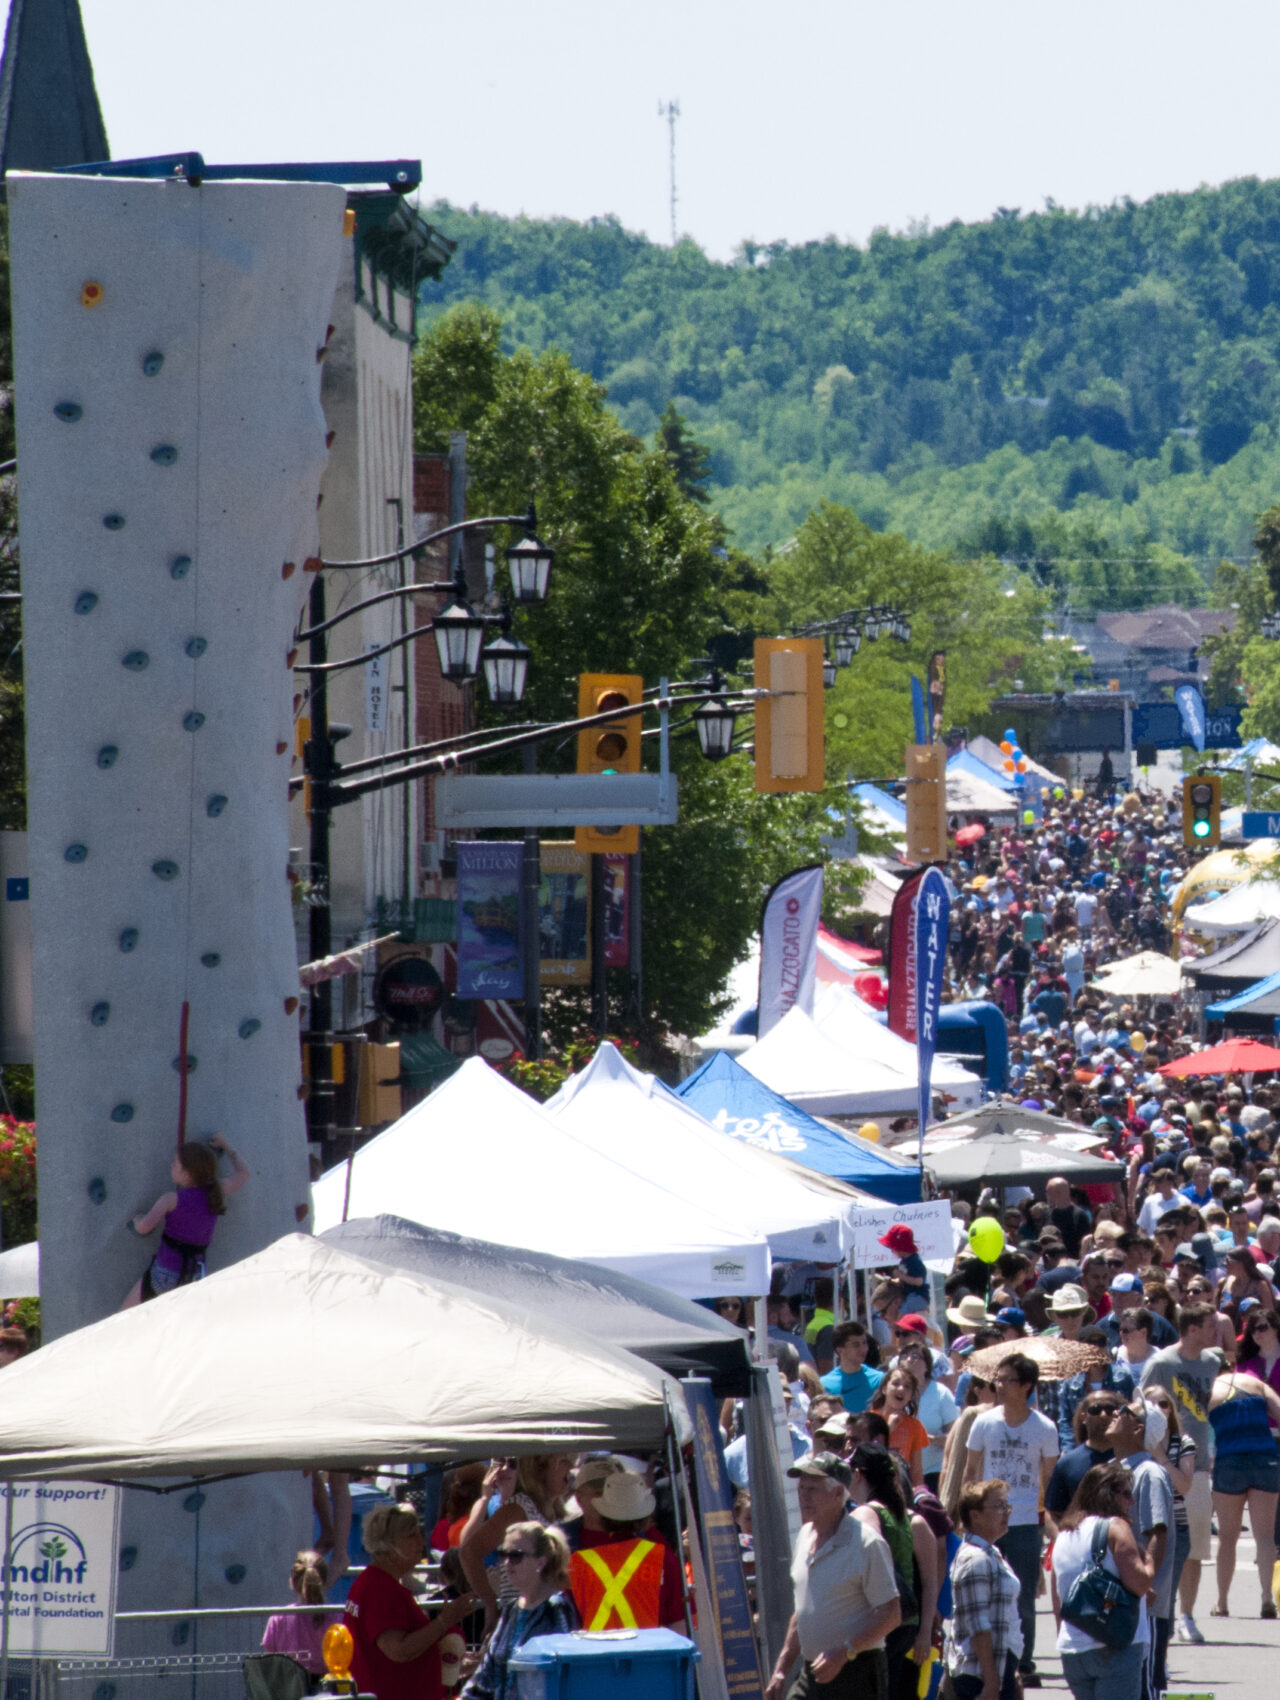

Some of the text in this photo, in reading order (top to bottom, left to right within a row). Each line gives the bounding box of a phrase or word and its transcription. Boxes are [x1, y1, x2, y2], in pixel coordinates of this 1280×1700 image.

[371, 686, 380, 728] HOTEL
[462, 857, 518, 870] MILTON
[923, 892, 942, 1042] WATER
[472, 971, 511, 991] play
[35, 1487, 107, 1502] support!
[43, 1591, 96, 1604] District
[34, 1607, 104, 1619] Foundation
